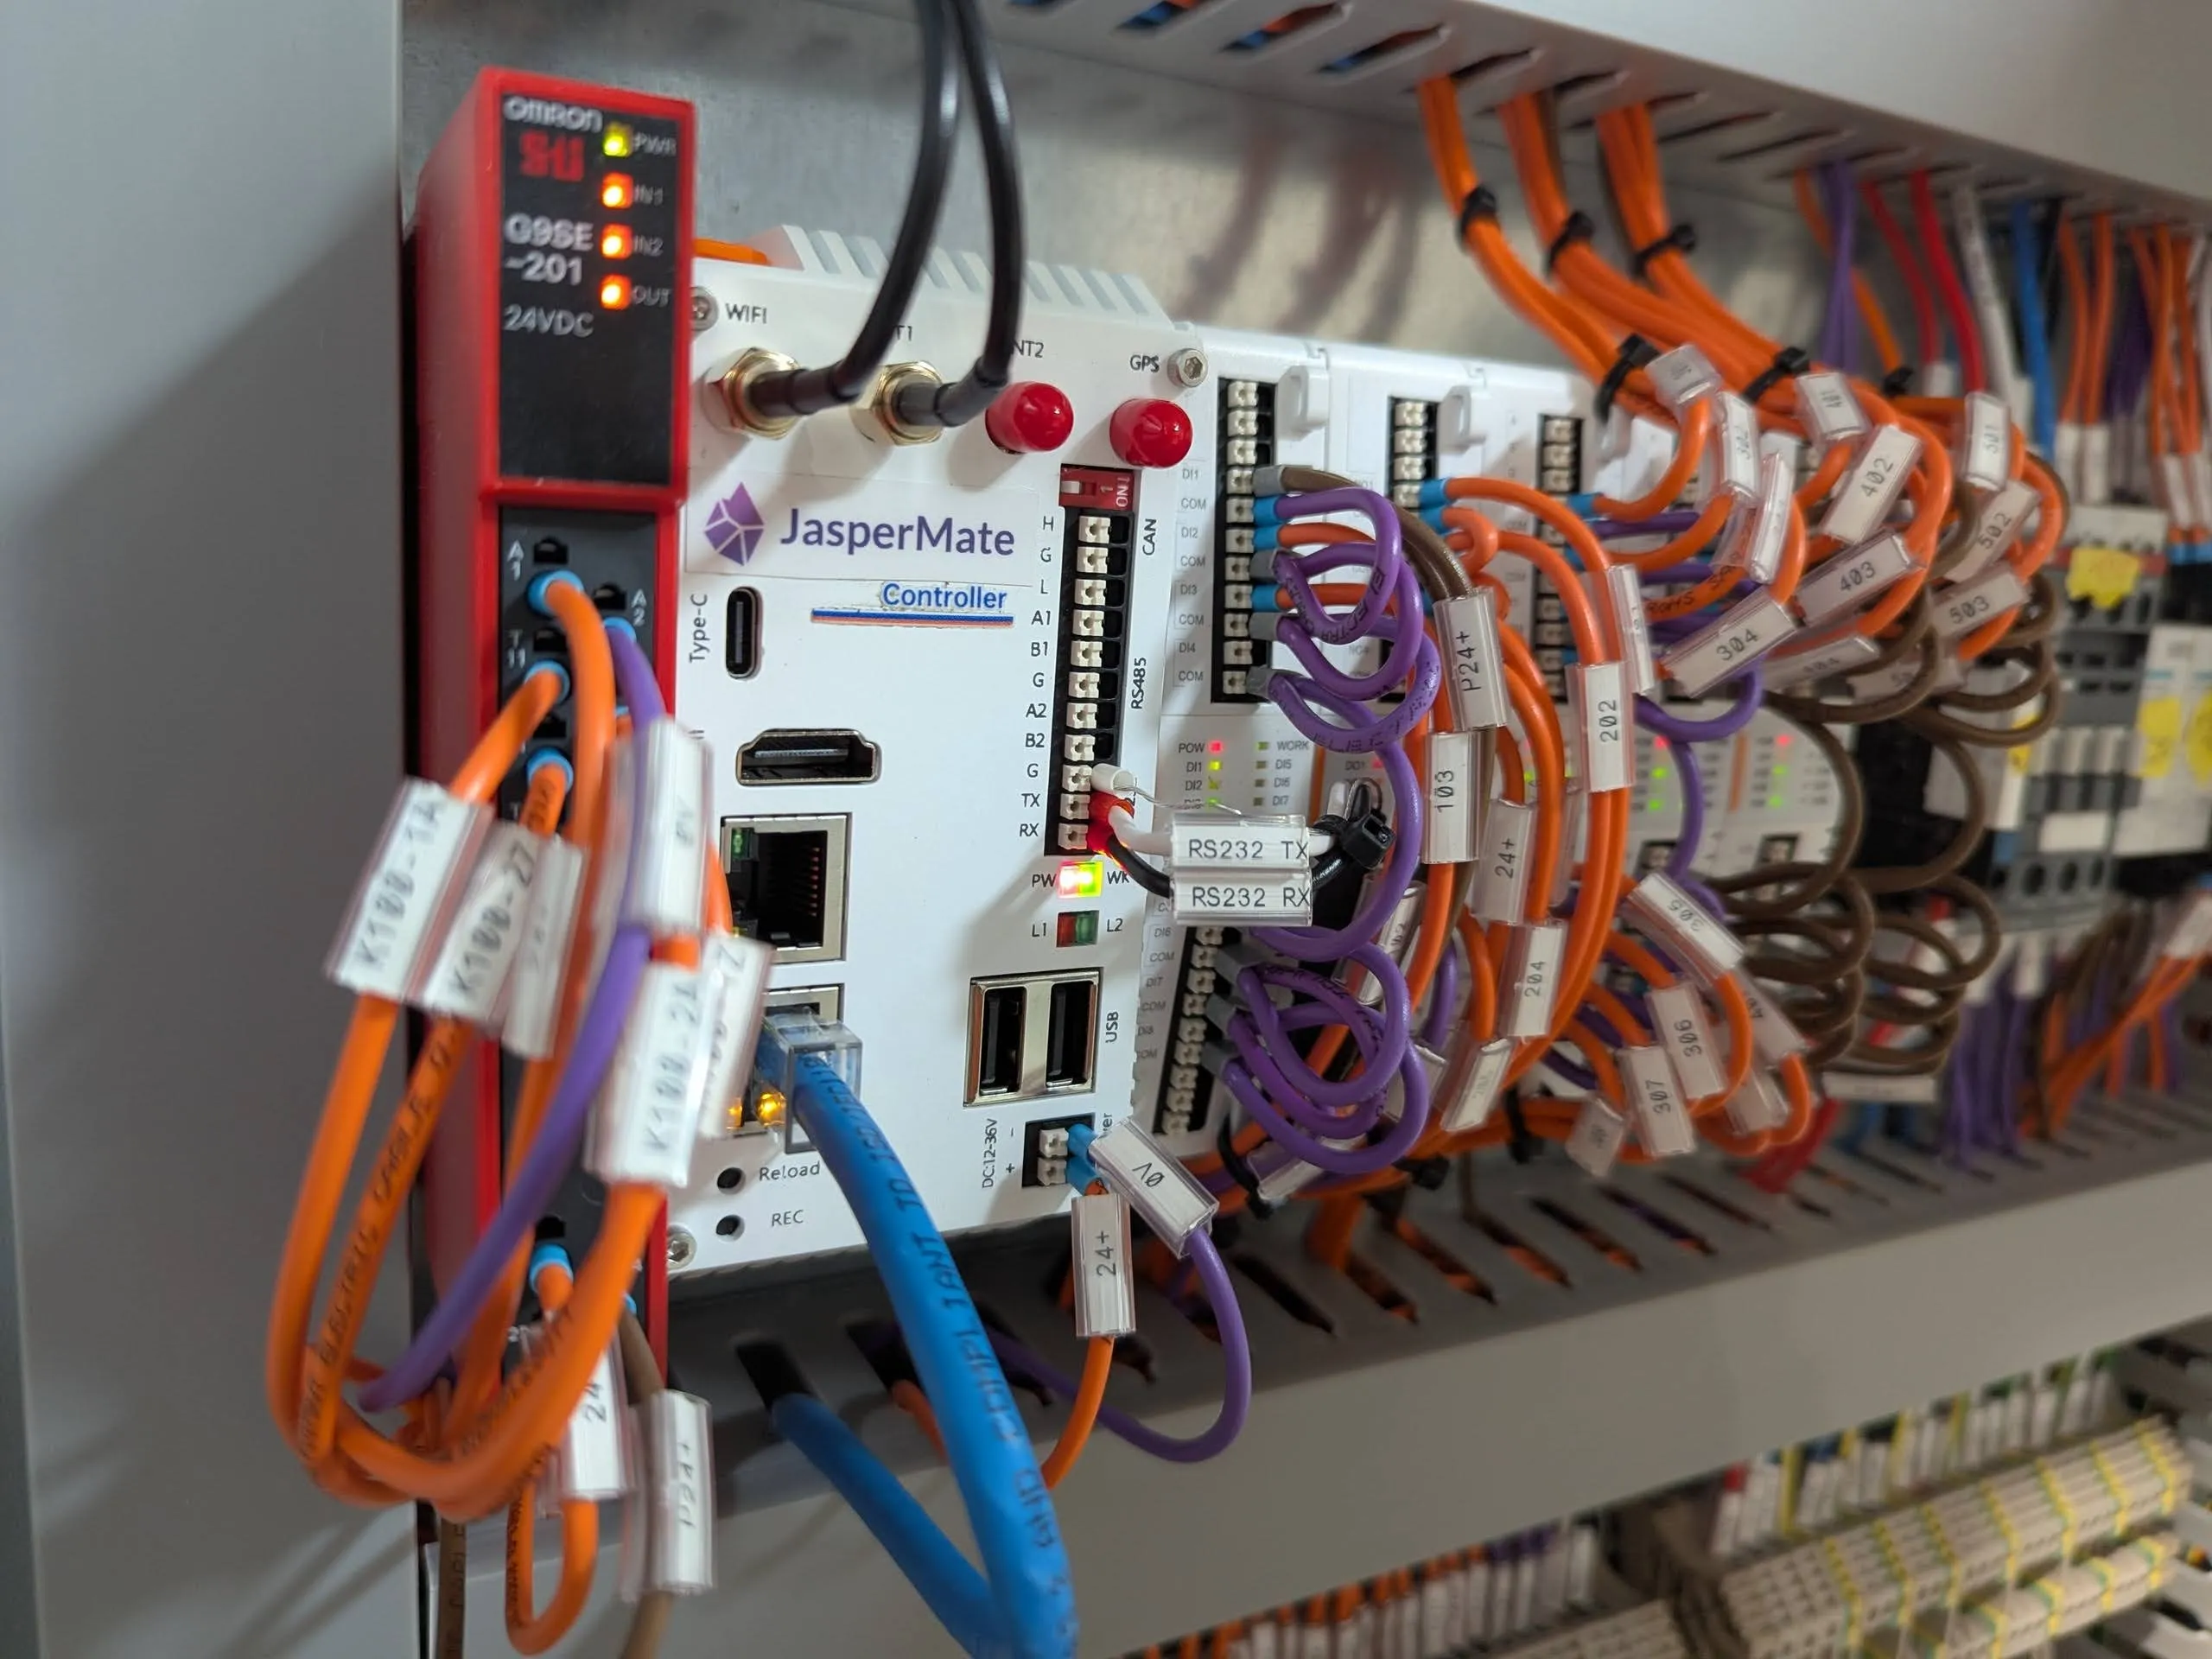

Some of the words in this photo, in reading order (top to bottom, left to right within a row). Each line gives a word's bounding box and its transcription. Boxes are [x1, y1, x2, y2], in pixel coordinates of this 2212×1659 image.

[633, 132, 677, 156] PWR
[505, 214, 594, 251] G9SE
[634, 235, 664, 256] IN2
[632, 285, 671, 307] OUT
[504, 306, 594, 338] 24VDC
[726, 302, 767, 325] WIFI
[1013, 340, 1046, 359] NT2
[1129, 354, 1160, 373] GPS
[1859, 456, 1894, 499] 402
[1181, 498, 1207, 510] COM
[780, 507, 1016, 556] JasperMate
[1042, 515, 1055, 532] H
[1181, 526, 1198, 539] DI2
[1975, 510, 2014, 552] 502
[1142, 518, 1157, 556] CAN
[1040, 548, 1052, 563] G
[1180, 556, 1206, 567] COM
[1039, 578, 1049, 595] L
[1839, 560, 1876, 594] 403
[880, 582, 1007, 610] Controller
[1180, 583, 1198, 596] DI3
[1031, 610, 1052, 626] A1
[1179, 614, 1205, 626] COM
[1948, 594, 1990, 626] 503
[690, 593, 709, 664] Type-C
[1030, 641, 1049, 658] B1
[1179, 642, 1196, 654] DI4
[1715, 628, 1760, 663] 304
[1455, 631, 1481, 693] P24+
[1033, 672, 1045, 688] G
[1130, 657, 1147, 709] RS485
[1178, 671, 1204, 682] COM
[1026, 702, 1047, 718] A2
[1599, 698, 1618, 743] 202
[1025, 733, 1046, 749] B2
[1178, 742, 1205, 754] POW
[1276, 740, 1310, 751] WORK
[1027, 763, 1039, 779] G
[1185, 761, 1203, 773] DI1
[1185, 779, 1203, 791] DI2
[1434, 768, 1454, 813] 103
[1021, 792, 1041, 808] TX
[1019, 823, 1039, 838] RX
[1188, 839, 1265, 860] RS232
[1281, 840, 1309, 860] TX
[1494, 837, 1516, 880] 24+
[1192, 887, 1267, 908] RS232
[1282, 887, 1311, 908] RX
[1106, 917, 1124, 934] L2
[1666, 897, 1706, 933] 305
[1032, 922, 1047, 938] L1
[1524, 959, 1548, 999] 204
[1105, 1010, 1120, 1043] USB
[1685, 1019, 1704, 1058] 306
[1644, 1077, 1672, 1116] 307
[982, 1118, 999, 1189] DC:12-36V
[760, 1160, 821, 1183] Reload
[771, 1210, 804, 1227] REC
[1096, 1230, 1117, 1277] 24+
